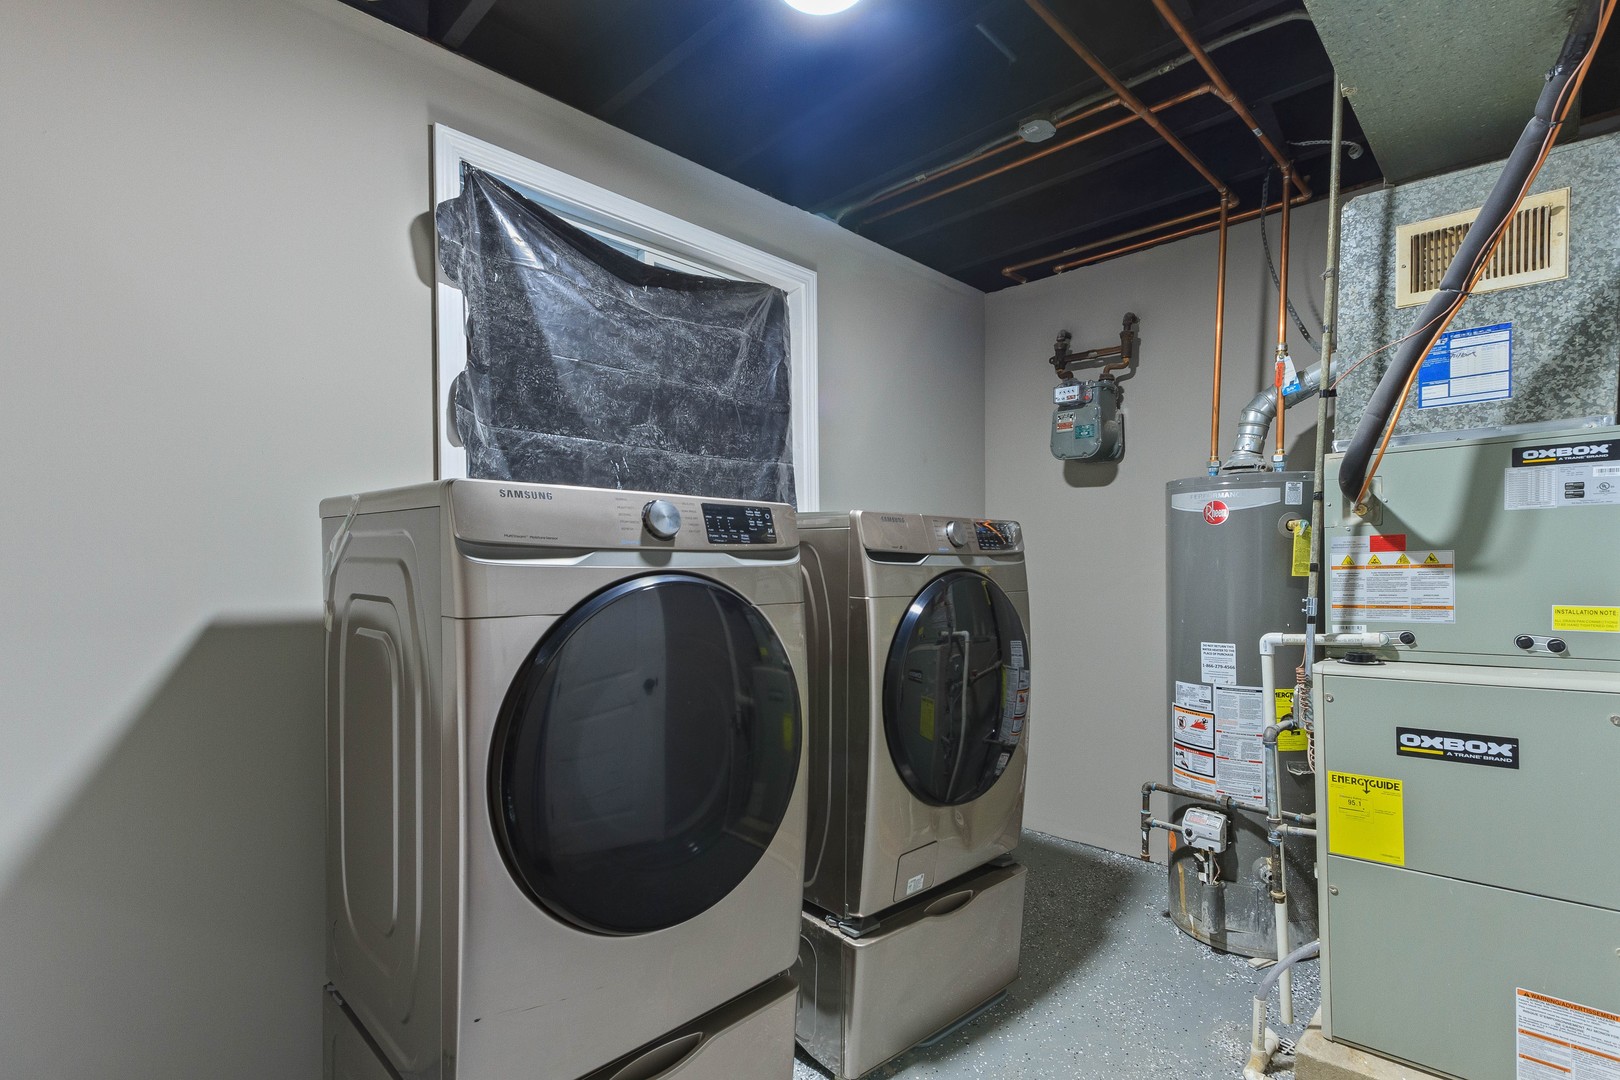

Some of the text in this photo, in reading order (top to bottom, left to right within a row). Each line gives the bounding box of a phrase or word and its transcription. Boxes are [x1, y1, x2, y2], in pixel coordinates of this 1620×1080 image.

[499, 489, 552, 500] SAMSUNG
[1206, 501, 1227, 520] Rheem
[1400, 734, 1512, 756] OXBOX
[1332, 775, 1400, 792] ENERGYGUIDE
